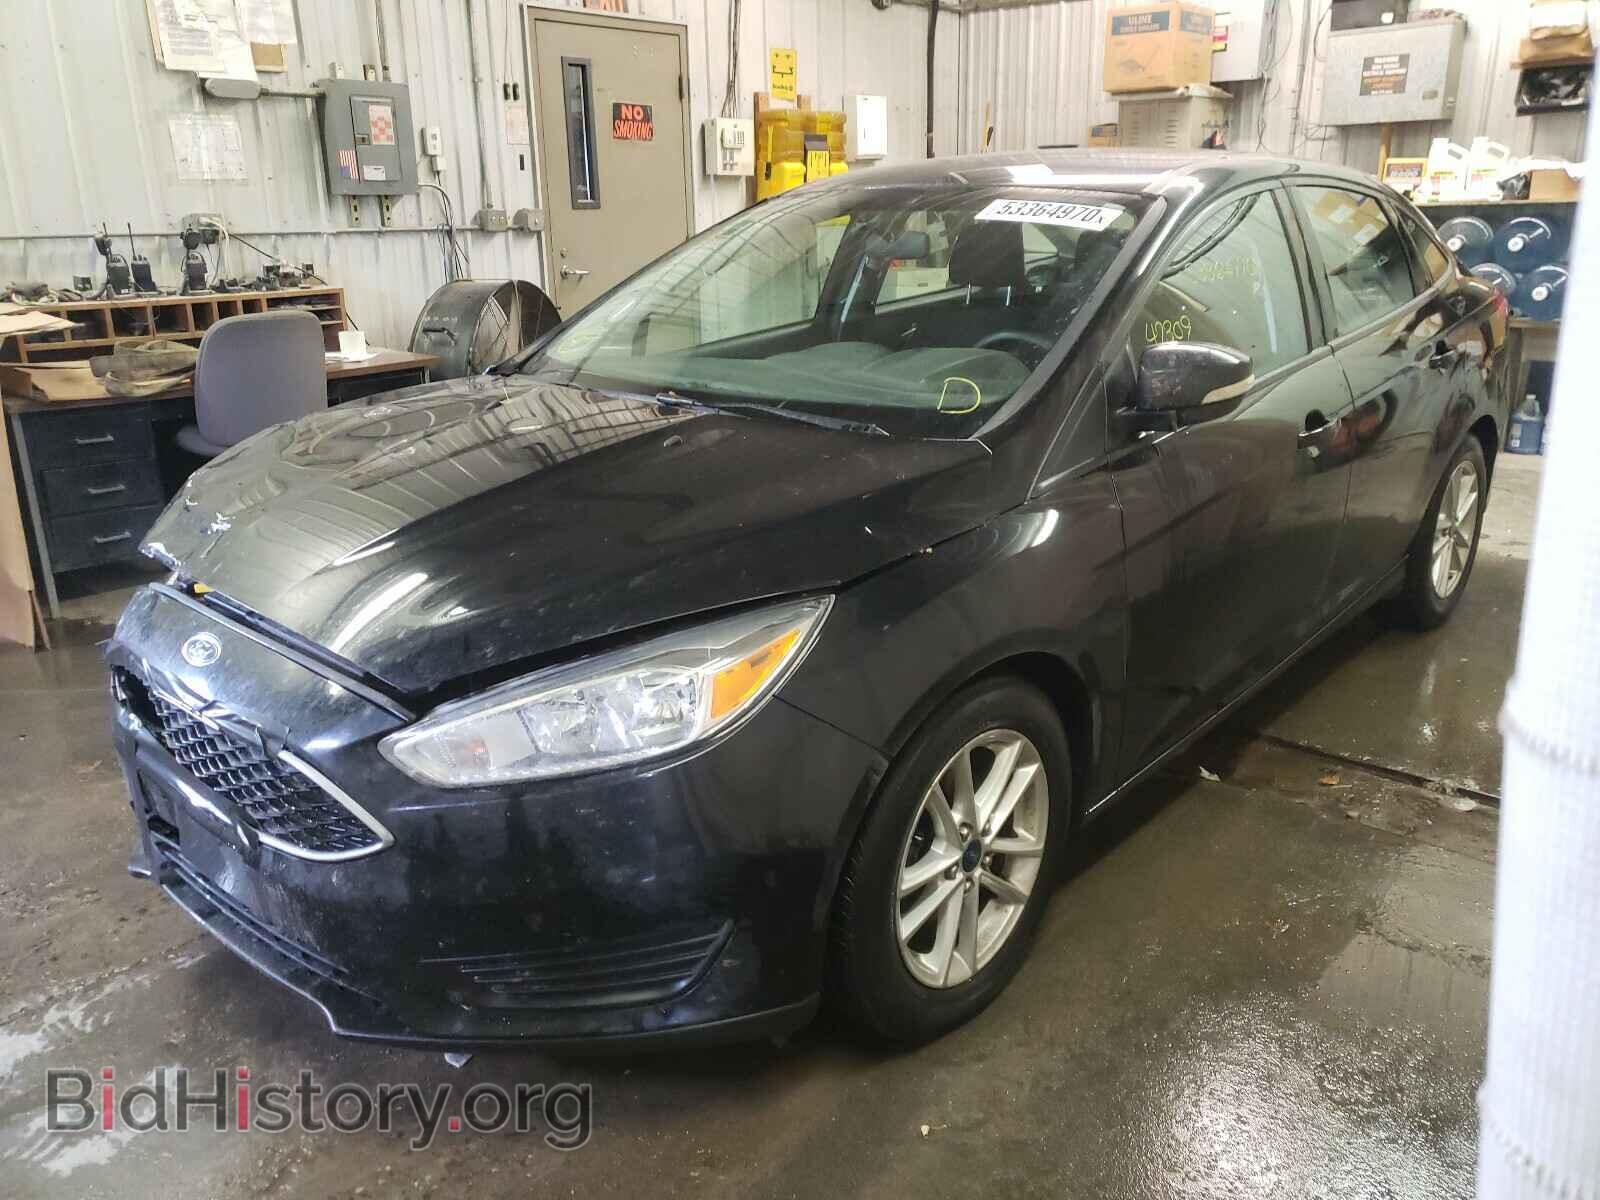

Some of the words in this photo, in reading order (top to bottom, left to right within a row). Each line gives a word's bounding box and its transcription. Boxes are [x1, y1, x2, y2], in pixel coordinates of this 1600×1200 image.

[621, 104, 644, 120] NO
[613, 119, 653, 139] SMOKING
[937, 377, 981, 414] D
